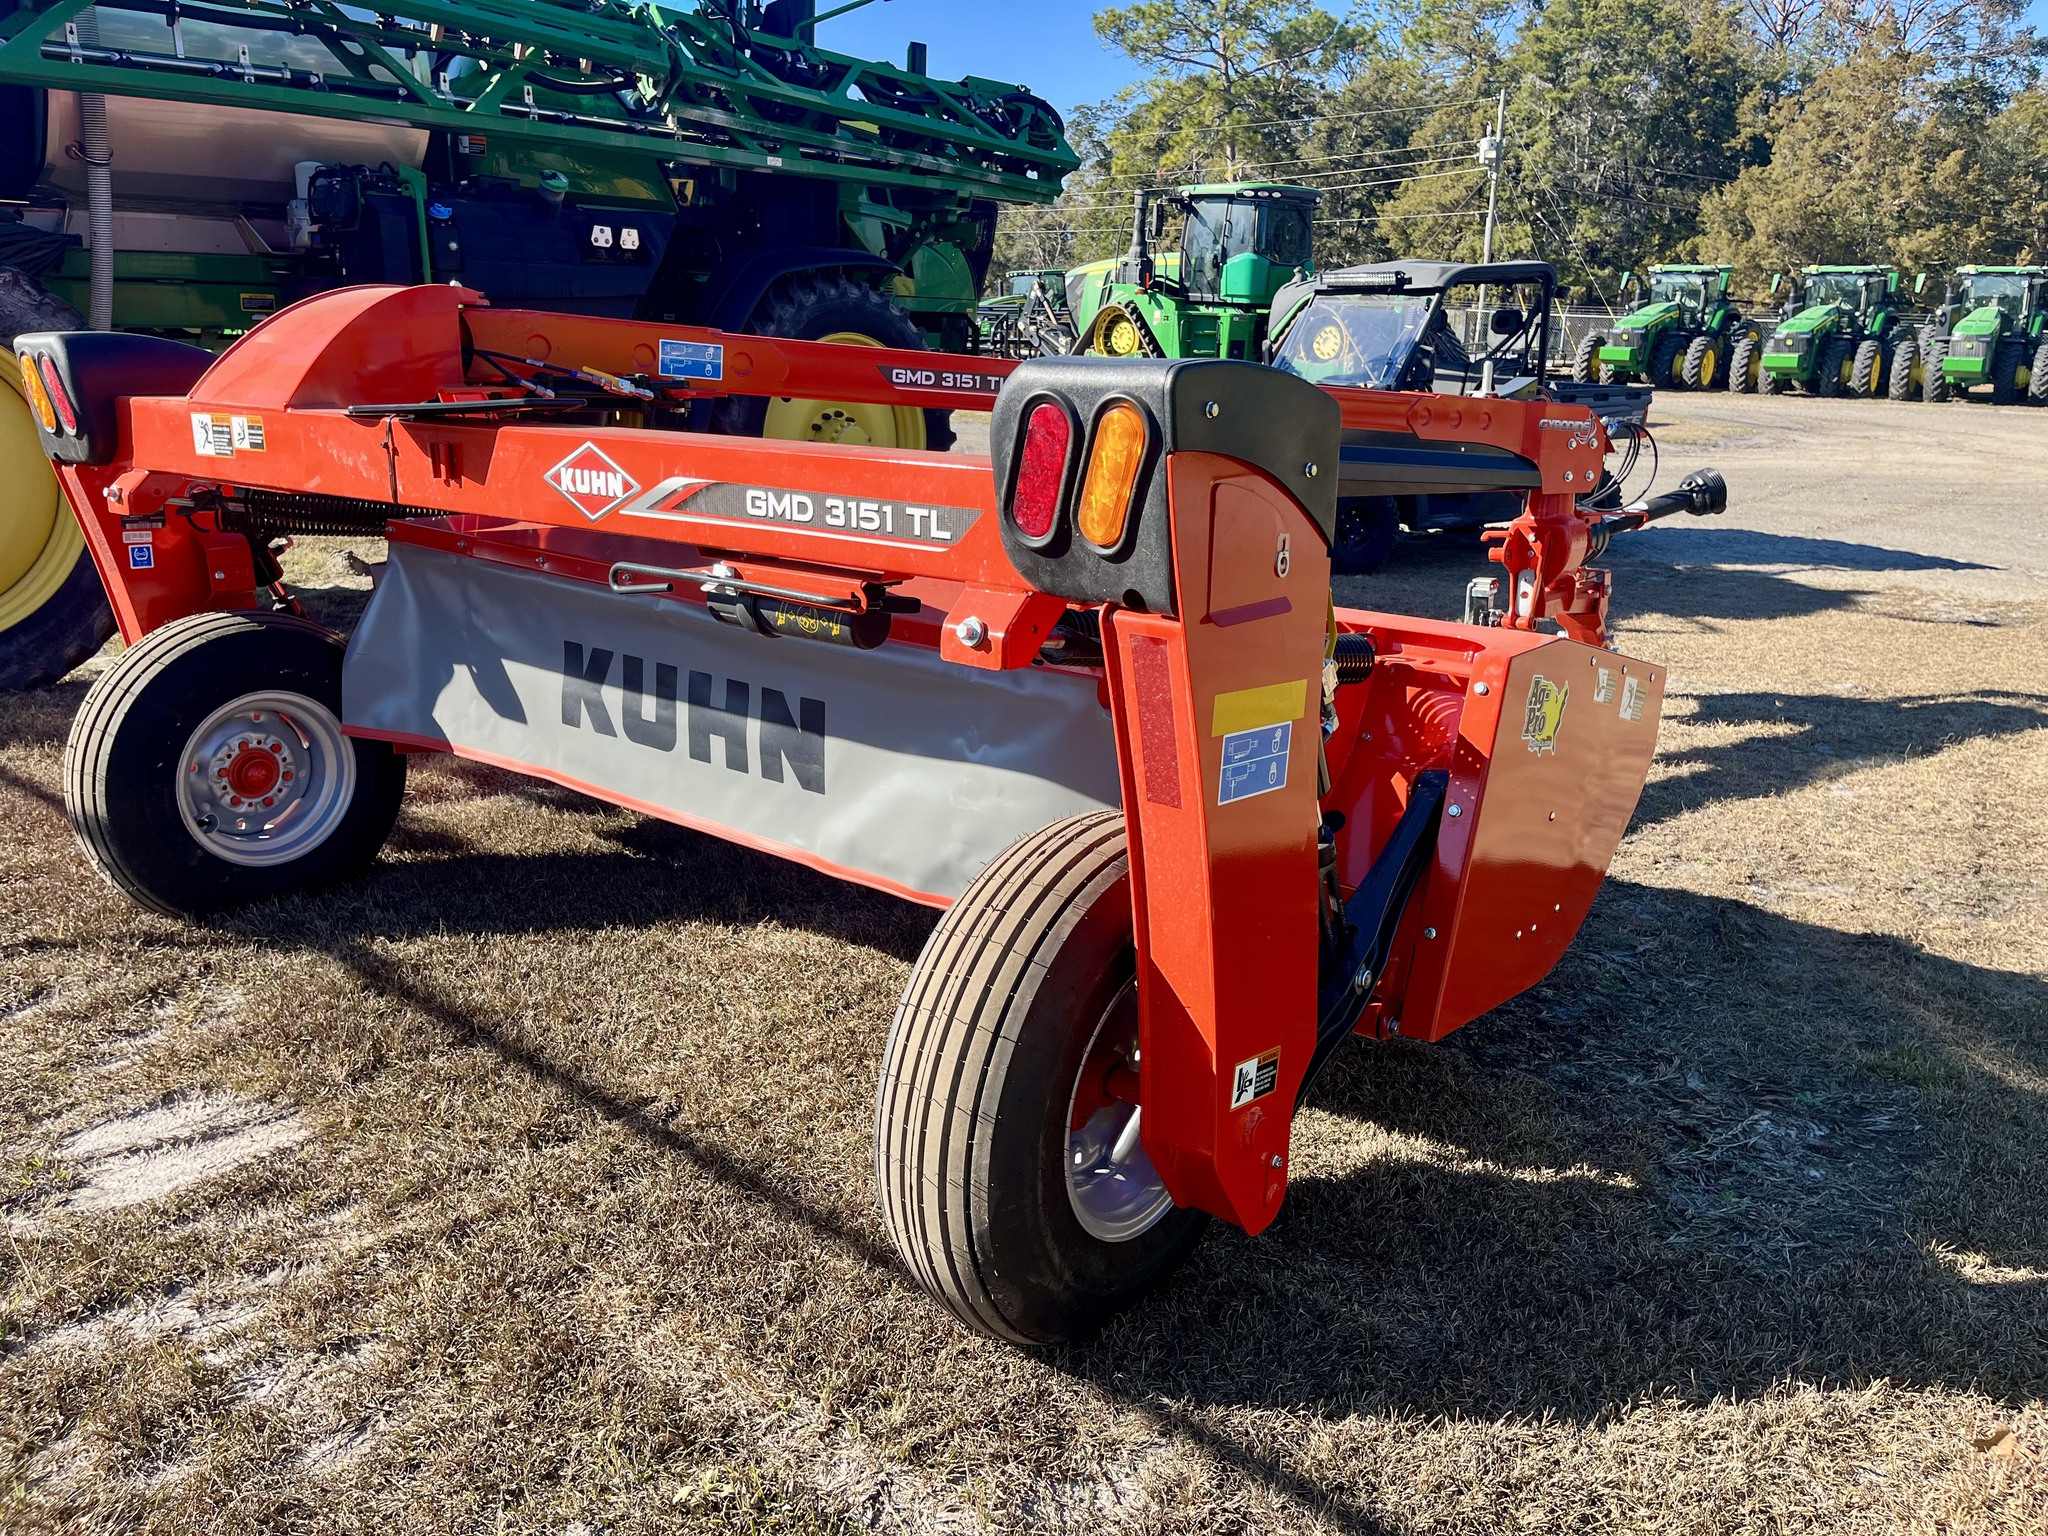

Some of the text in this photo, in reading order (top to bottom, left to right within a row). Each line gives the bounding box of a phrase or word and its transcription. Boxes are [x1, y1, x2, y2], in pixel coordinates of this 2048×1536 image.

[892, 368, 936, 386] GMD
[941, 372, 981, 389] 3151
[1538, 418, 1591, 432] GYRODINE
[560, 466, 624, 499] KUHN
[745, 489, 952, 540] GMD 3151 TL
[561, 640, 826, 795] KUHN
[1524, 707, 1546, 738] Pro
